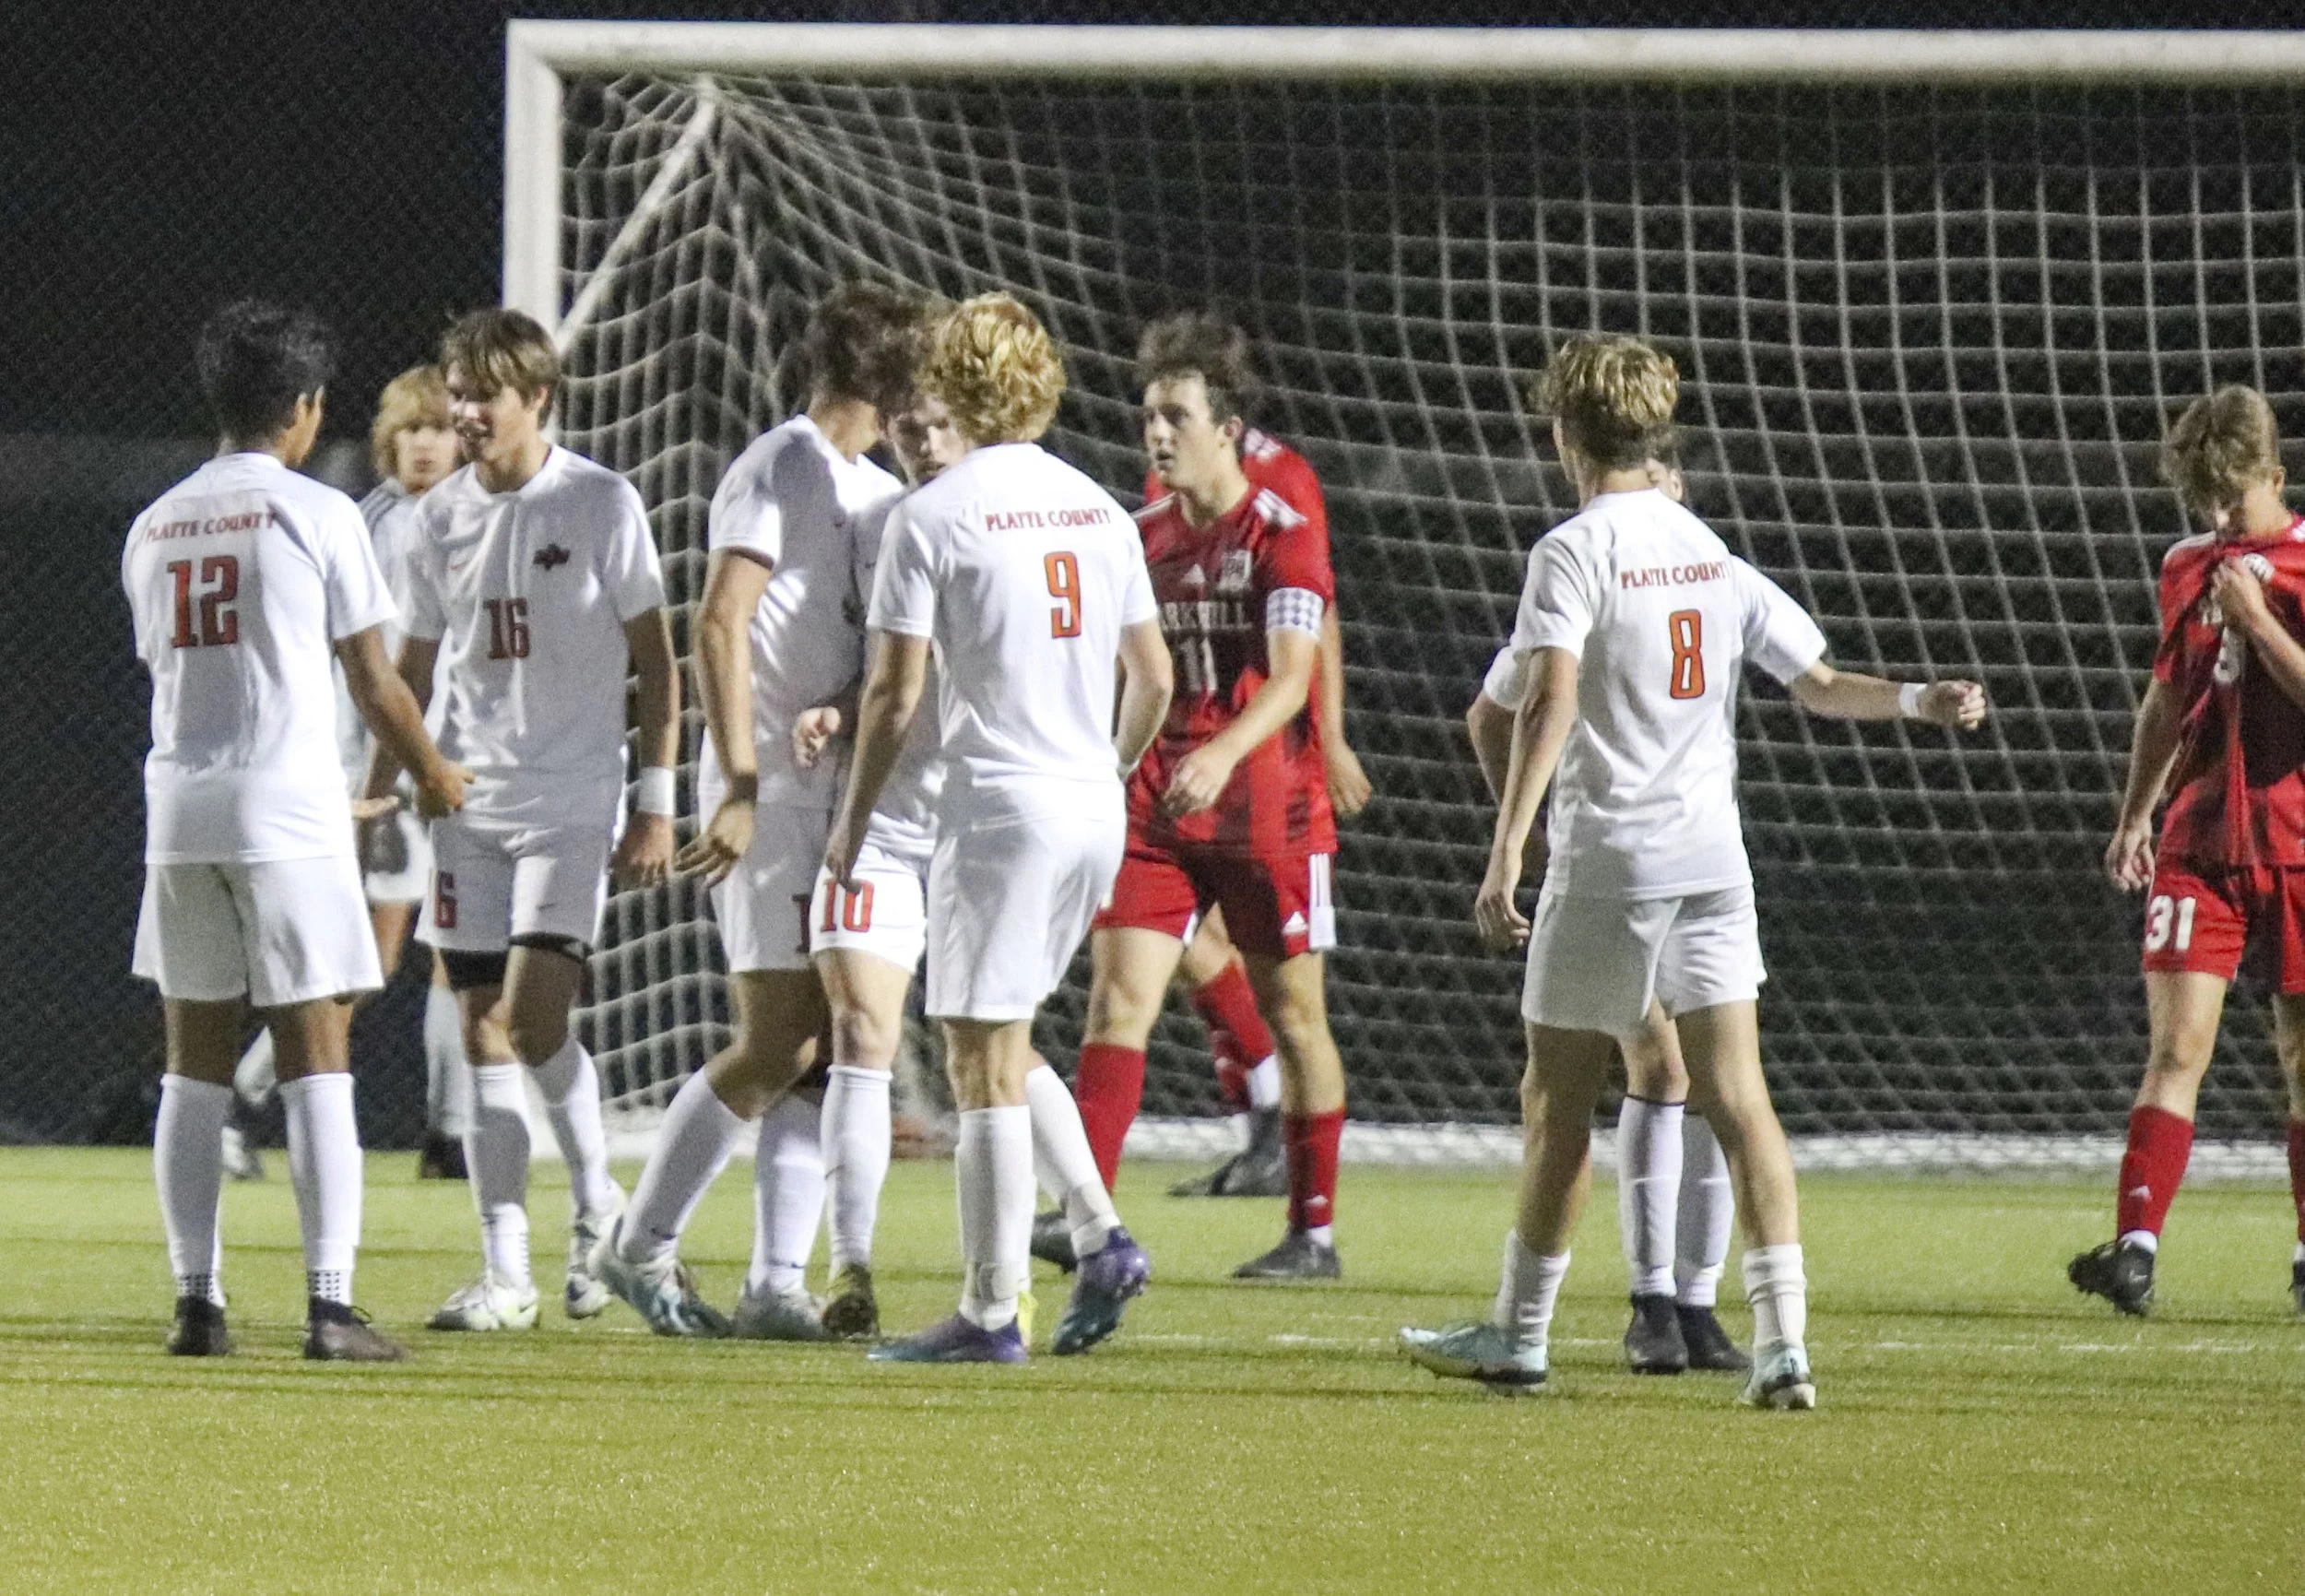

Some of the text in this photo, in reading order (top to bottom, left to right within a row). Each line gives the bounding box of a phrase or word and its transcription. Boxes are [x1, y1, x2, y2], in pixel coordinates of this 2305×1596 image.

[985, 508, 1112, 532] PLATTE COUNTY
[166, 555, 239, 648] 12
[1043, 550, 1082, 639] 9
[1620, 568, 1669, 589] PLATTE
[482, 597, 531, 660] 16
[1669, 609, 1706, 700] 8
[432, 869, 458, 928] 6
[820, 878, 875, 933] 10
[2145, 894, 2196, 952] 31
